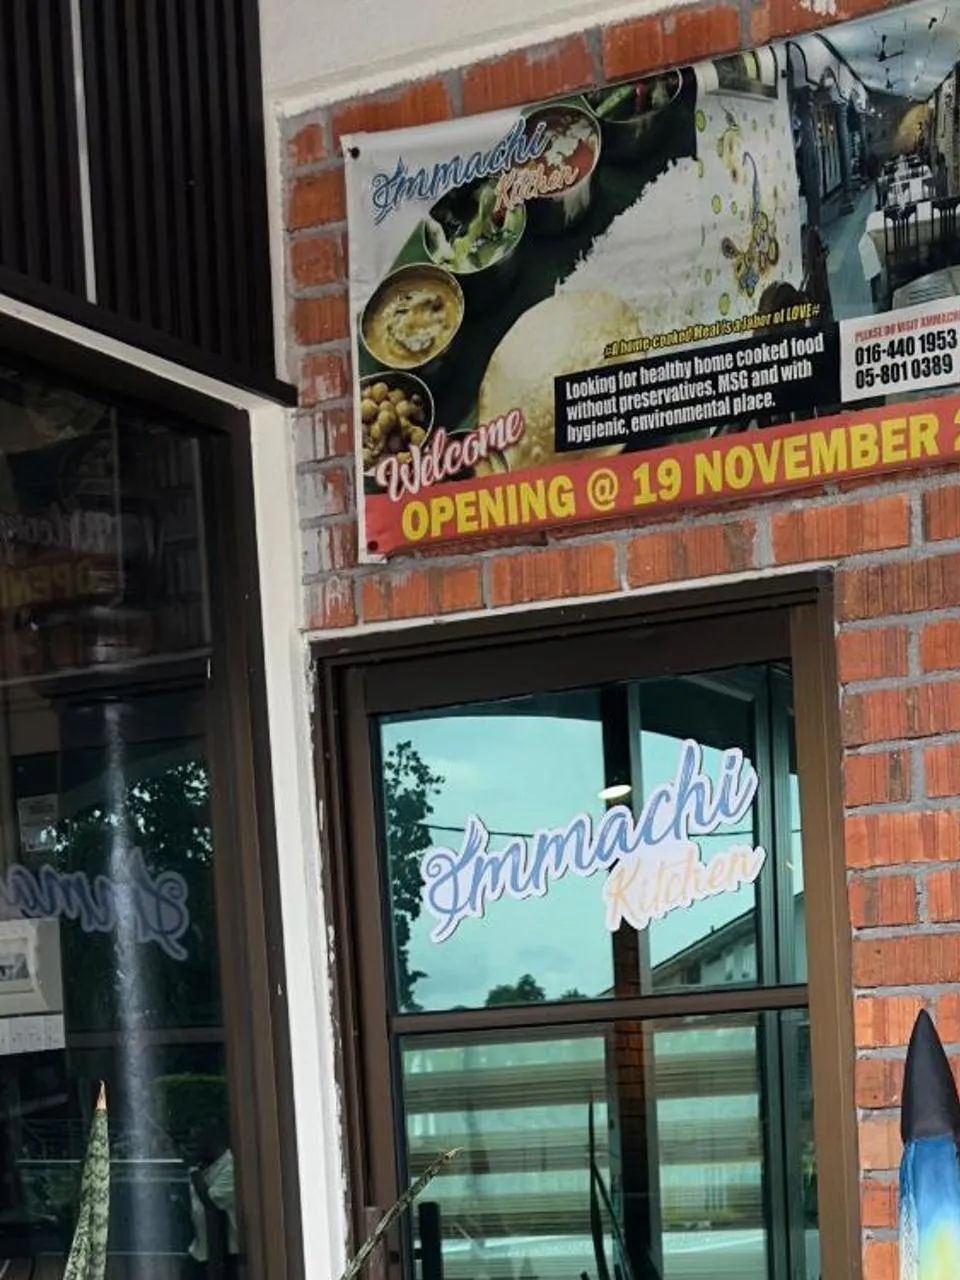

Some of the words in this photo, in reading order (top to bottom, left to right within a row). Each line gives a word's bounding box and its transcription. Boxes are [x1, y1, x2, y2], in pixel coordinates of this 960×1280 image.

[372, 116, 549, 225] Ammachi
[566, 376, 617, 401] Looking
[618, 369, 637, 391] for
[640, 358, 692, 386] healthy
[694, 352, 733, 377] home
[736, 338, 789, 367] cooked
[791, 331, 824, 357] food
[855, 335, 915, 366] 016-440
[918, 328, 958, 354] 1953
[855, 360, 908, 389] 05-801
[911, 353, 953, 379] 0389
[566, 394, 617, 421] without
[619, 379, 716, 414] preservatives,
[718, 371, 748, 393] MSG
[751, 363, 778, 387] and
[781, 357, 812, 383] with
[567, 414, 630, 444] hygienic,
[631, 397, 730, 433] environmental
[733, 389, 776, 420] place.
[375, 407, 527, 501] Welcome
[402, 475, 577, 541] OPENING
[587, 468, 619, 511] @
[633, 457, 682, 506] 19
[695, 412, 940, 495] NOVEMBER
[421, 738, 759, 943] Ammachi
[605, 842, 765, 931] Kitchen
